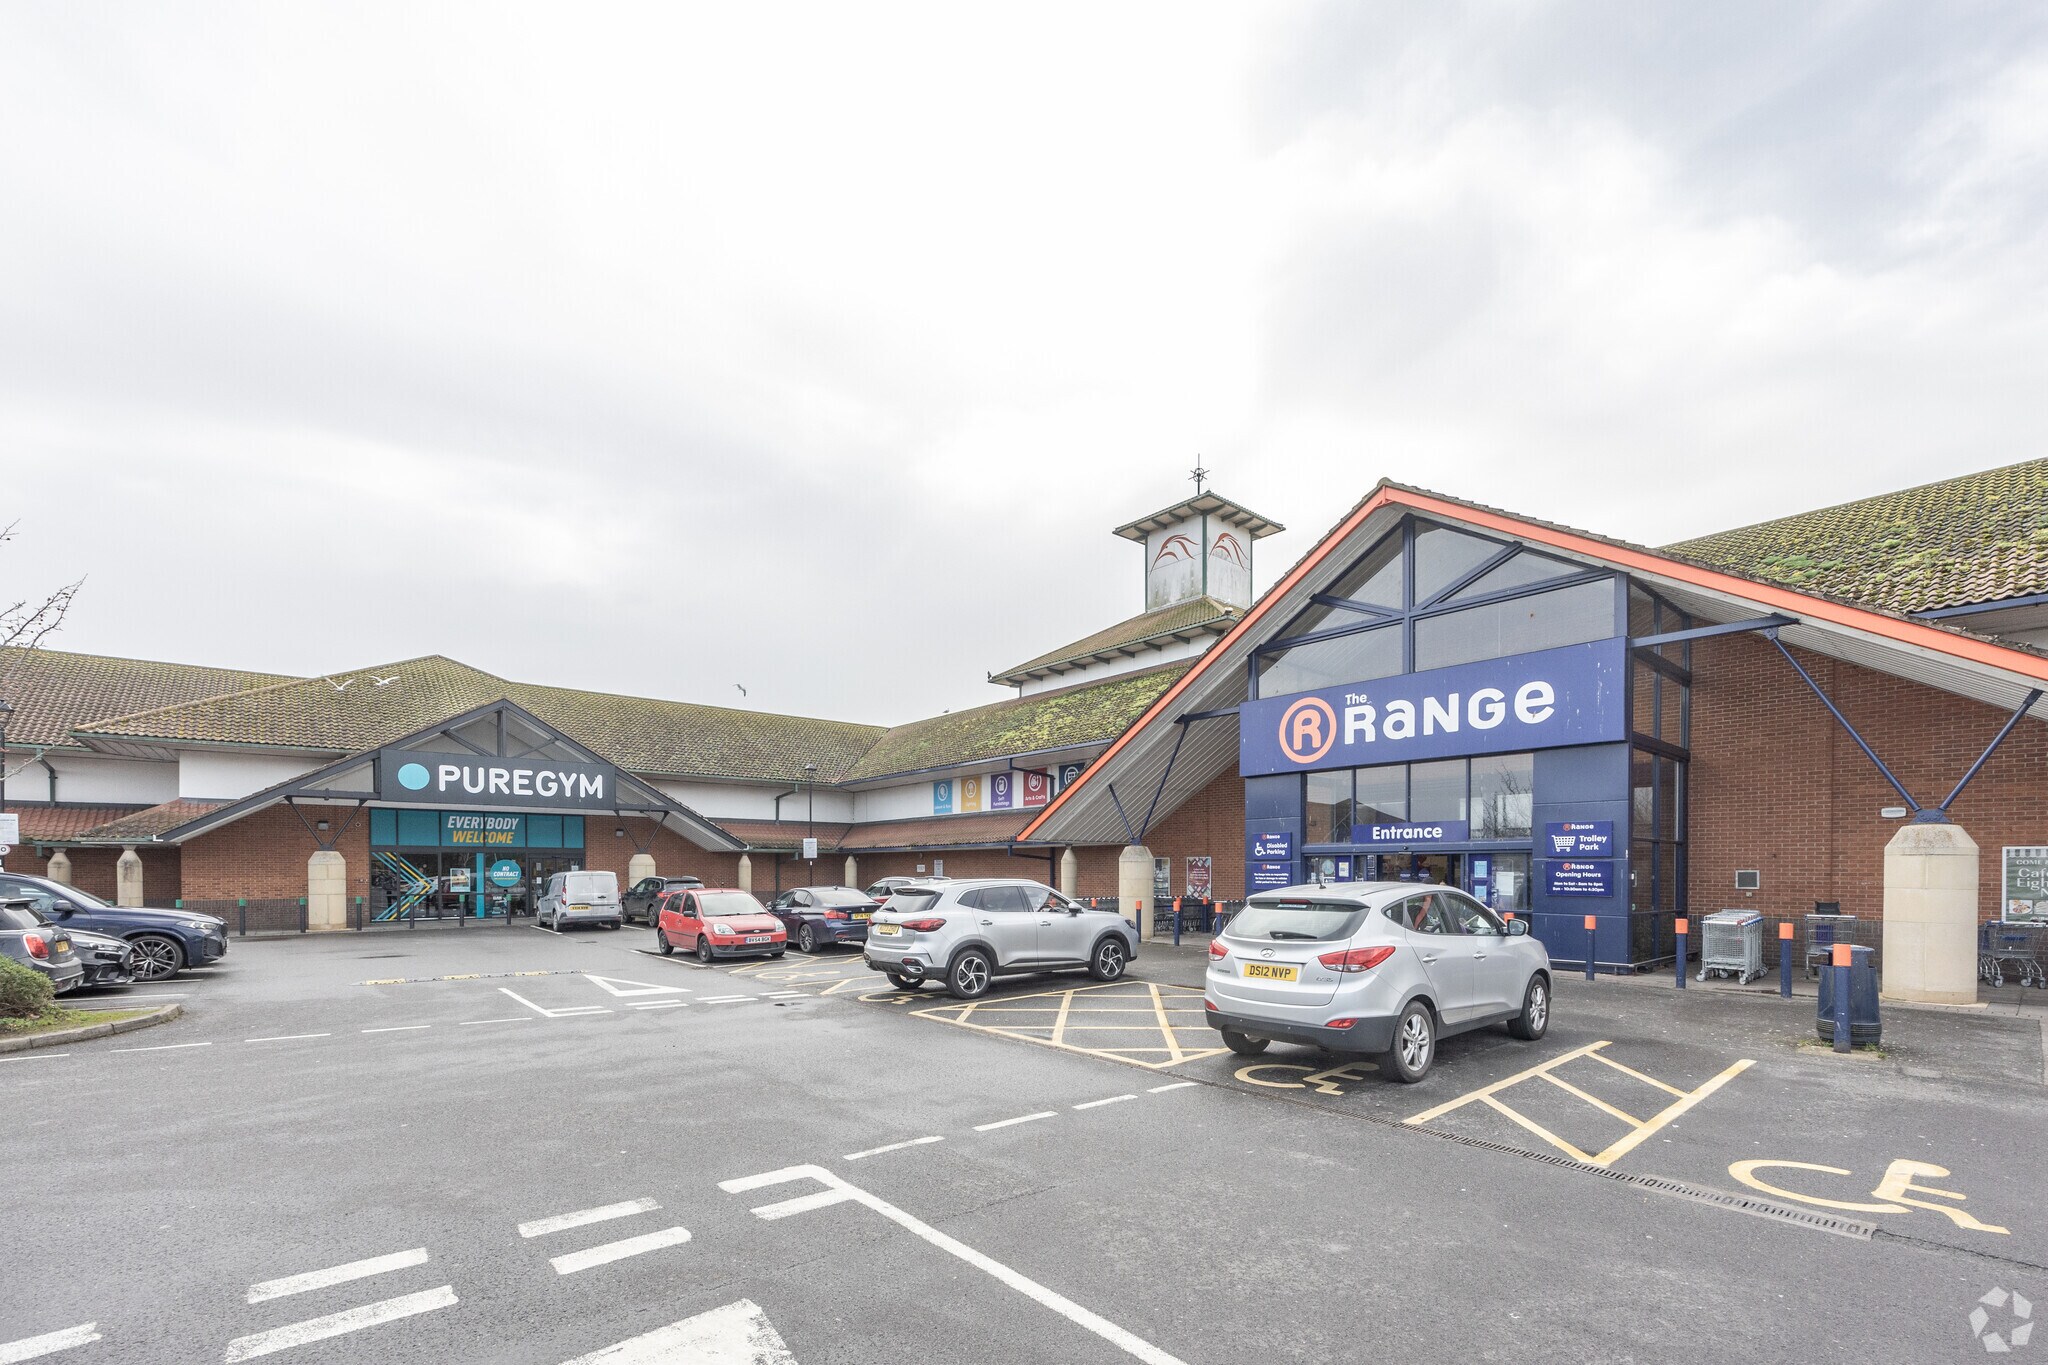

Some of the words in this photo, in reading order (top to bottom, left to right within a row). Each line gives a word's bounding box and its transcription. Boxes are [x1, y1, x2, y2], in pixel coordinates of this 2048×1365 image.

[1345, 693, 1367, 705] The
[438, 764, 603, 799] PUREGYM
[447, 815, 519, 830] EVERYBODY
[452, 830, 514, 844] WELCOME
[1372, 826, 1443, 840] Entrance
[1579, 835, 1607, 843] Trolley
[1249, 965, 1269, 976] DS12
[1271, 967, 1291, 979] NVP
